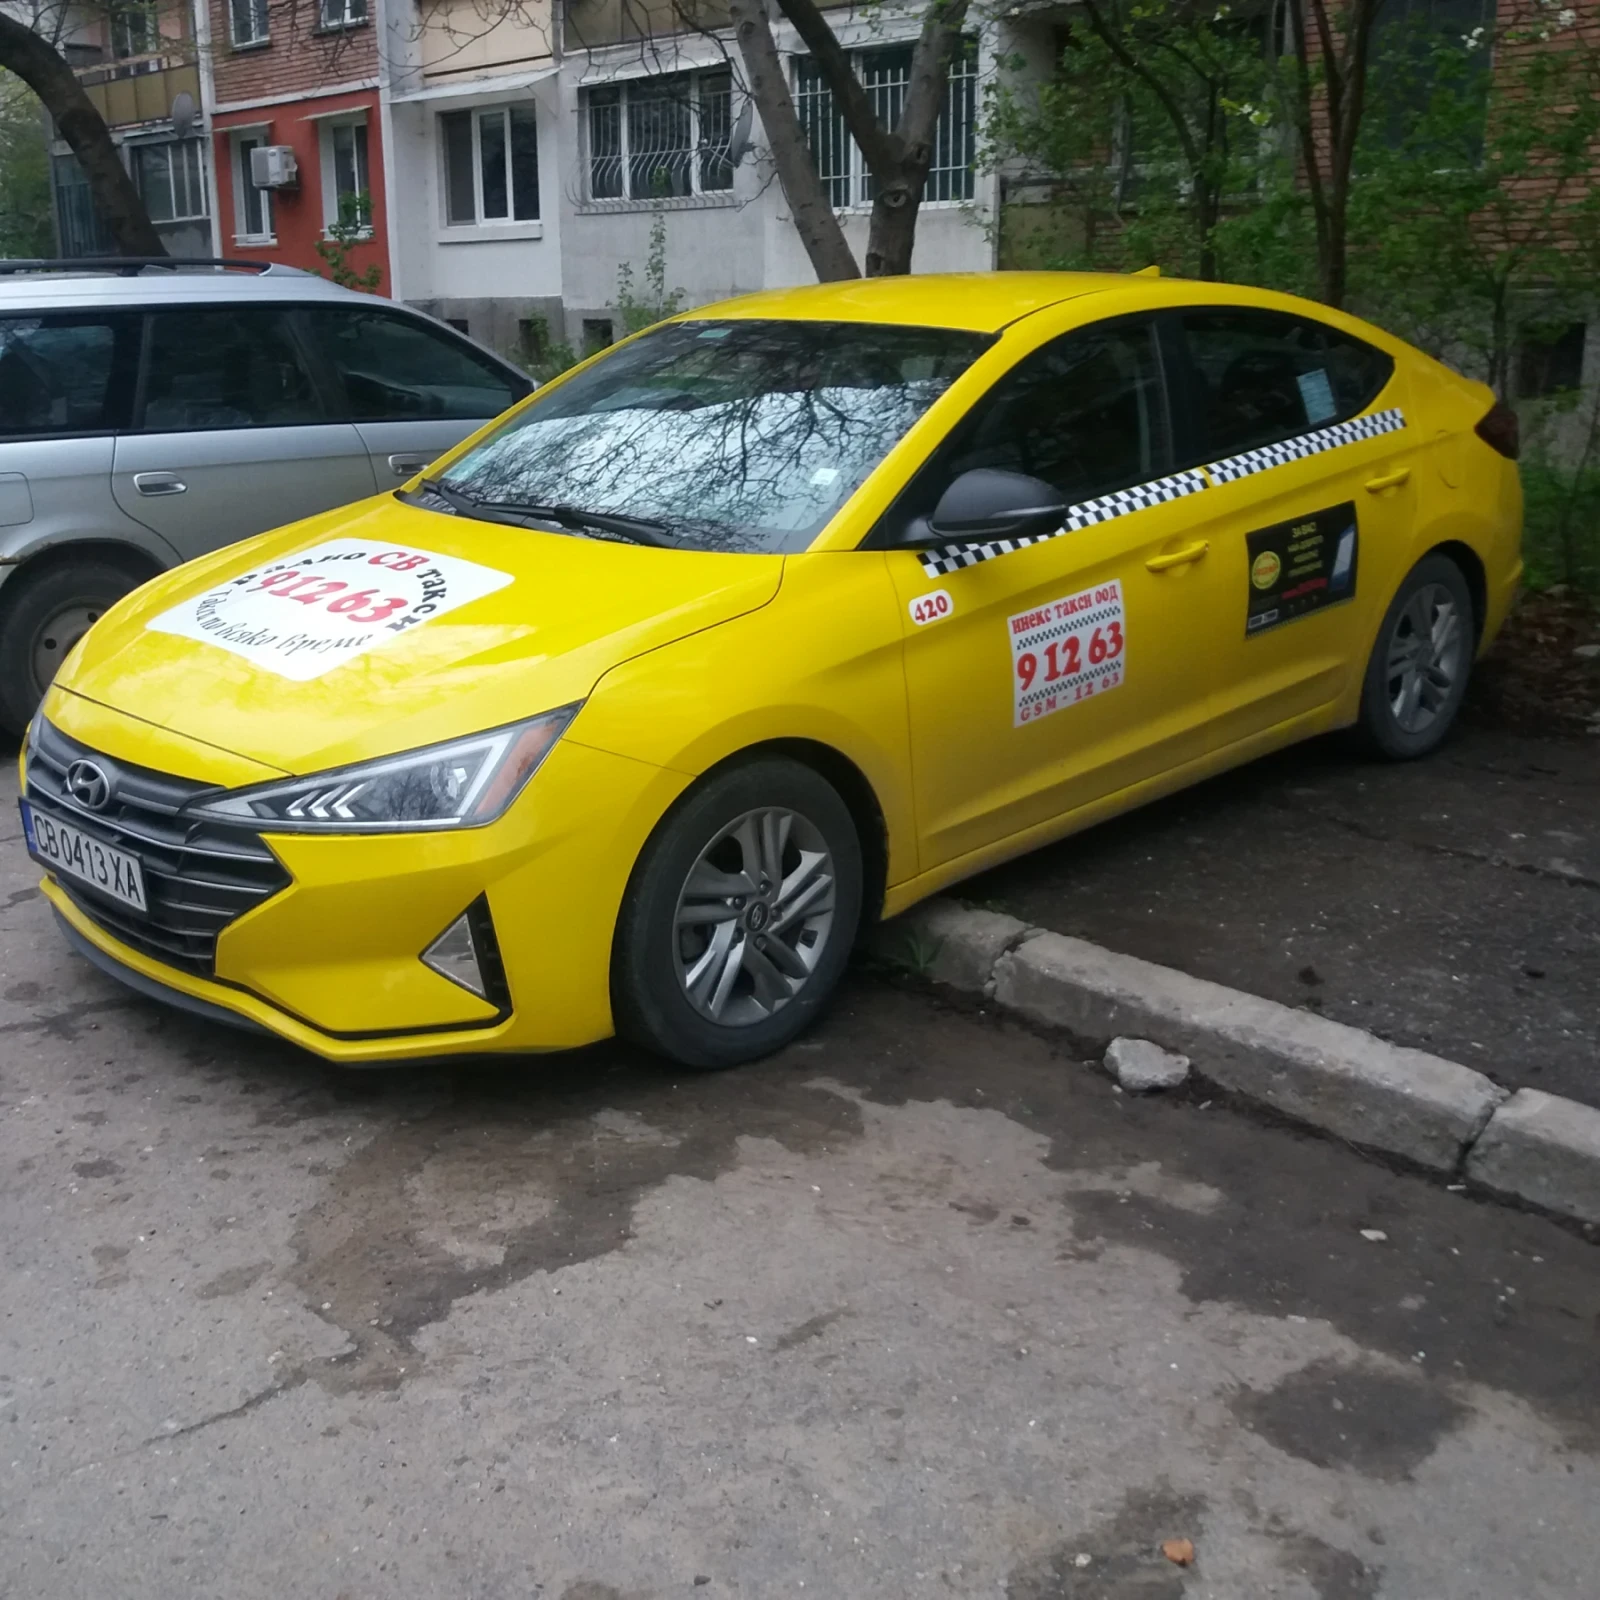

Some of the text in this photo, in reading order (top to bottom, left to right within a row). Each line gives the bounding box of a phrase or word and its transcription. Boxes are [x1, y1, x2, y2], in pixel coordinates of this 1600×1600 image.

[367, 552, 430, 571] СВ
[384, 568, 447, 632] такси
[915, 595, 948, 622] 420
[200, 612, 225, 631] по
[220, 622, 279, 647] всяко
[275, 633, 374, 656] време
[1020, 695, 1057, 721] GSM
